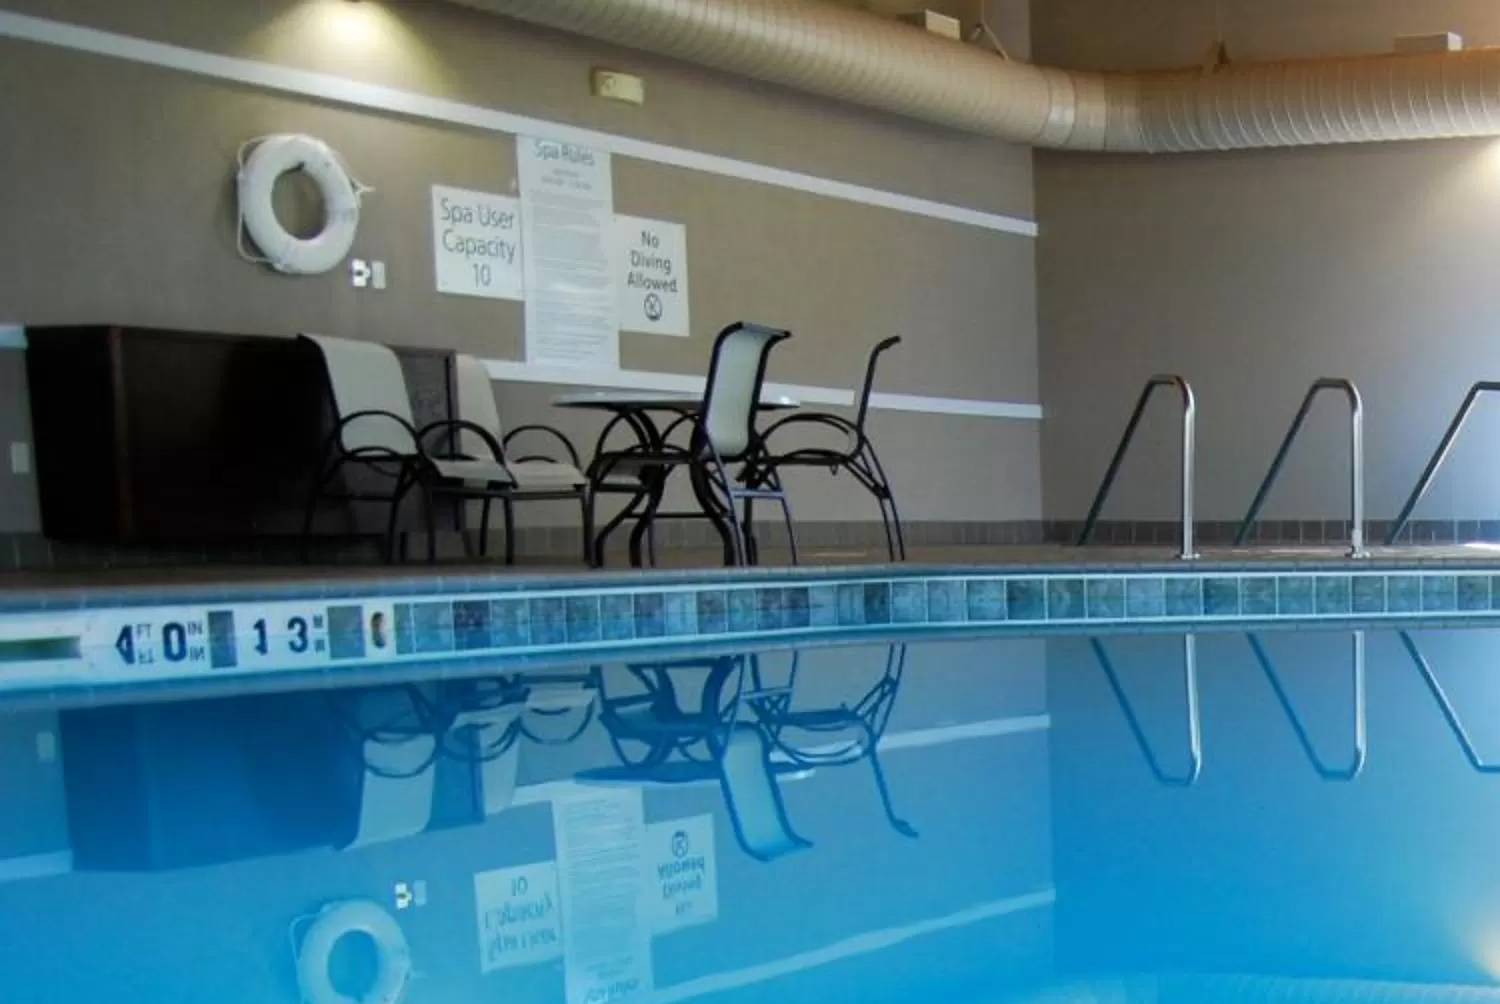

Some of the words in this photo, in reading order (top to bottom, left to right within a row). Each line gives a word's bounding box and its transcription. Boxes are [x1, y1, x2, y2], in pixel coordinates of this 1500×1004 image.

[440, 197, 473, 226] Spa
[479, 203, 515, 230] User
[442, 228, 517, 264] Capacity
[641, 230, 660, 248] No
[630, 250, 672, 275] Diving
[473, 263, 492, 288] 10
[627, 271, 678, 294] Allowed
